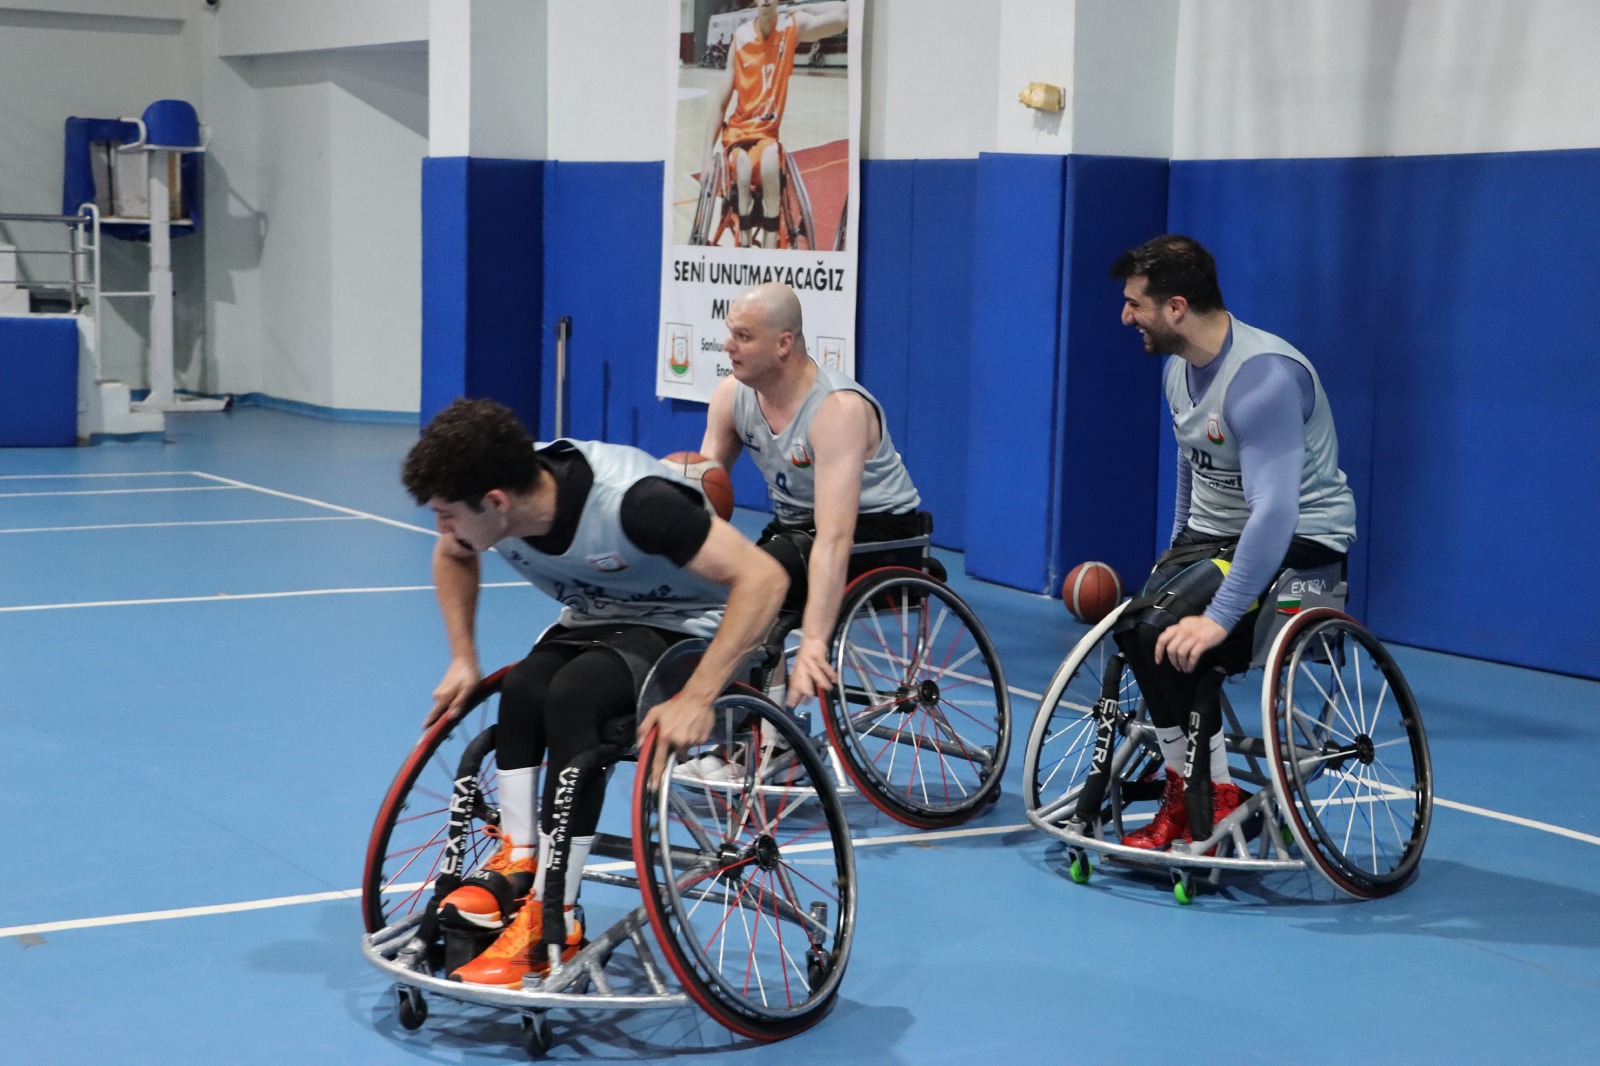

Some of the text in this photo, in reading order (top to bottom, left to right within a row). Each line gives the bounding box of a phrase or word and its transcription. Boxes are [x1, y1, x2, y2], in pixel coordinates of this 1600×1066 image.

[674, 255, 845, 291] SENİ UNUTMAYACAĞIZ
[1088, 698, 1117, 776] EXTRA
[440, 775, 473, 874] EXTRA
[552, 767, 581, 871] THE WHEELCHAIR
